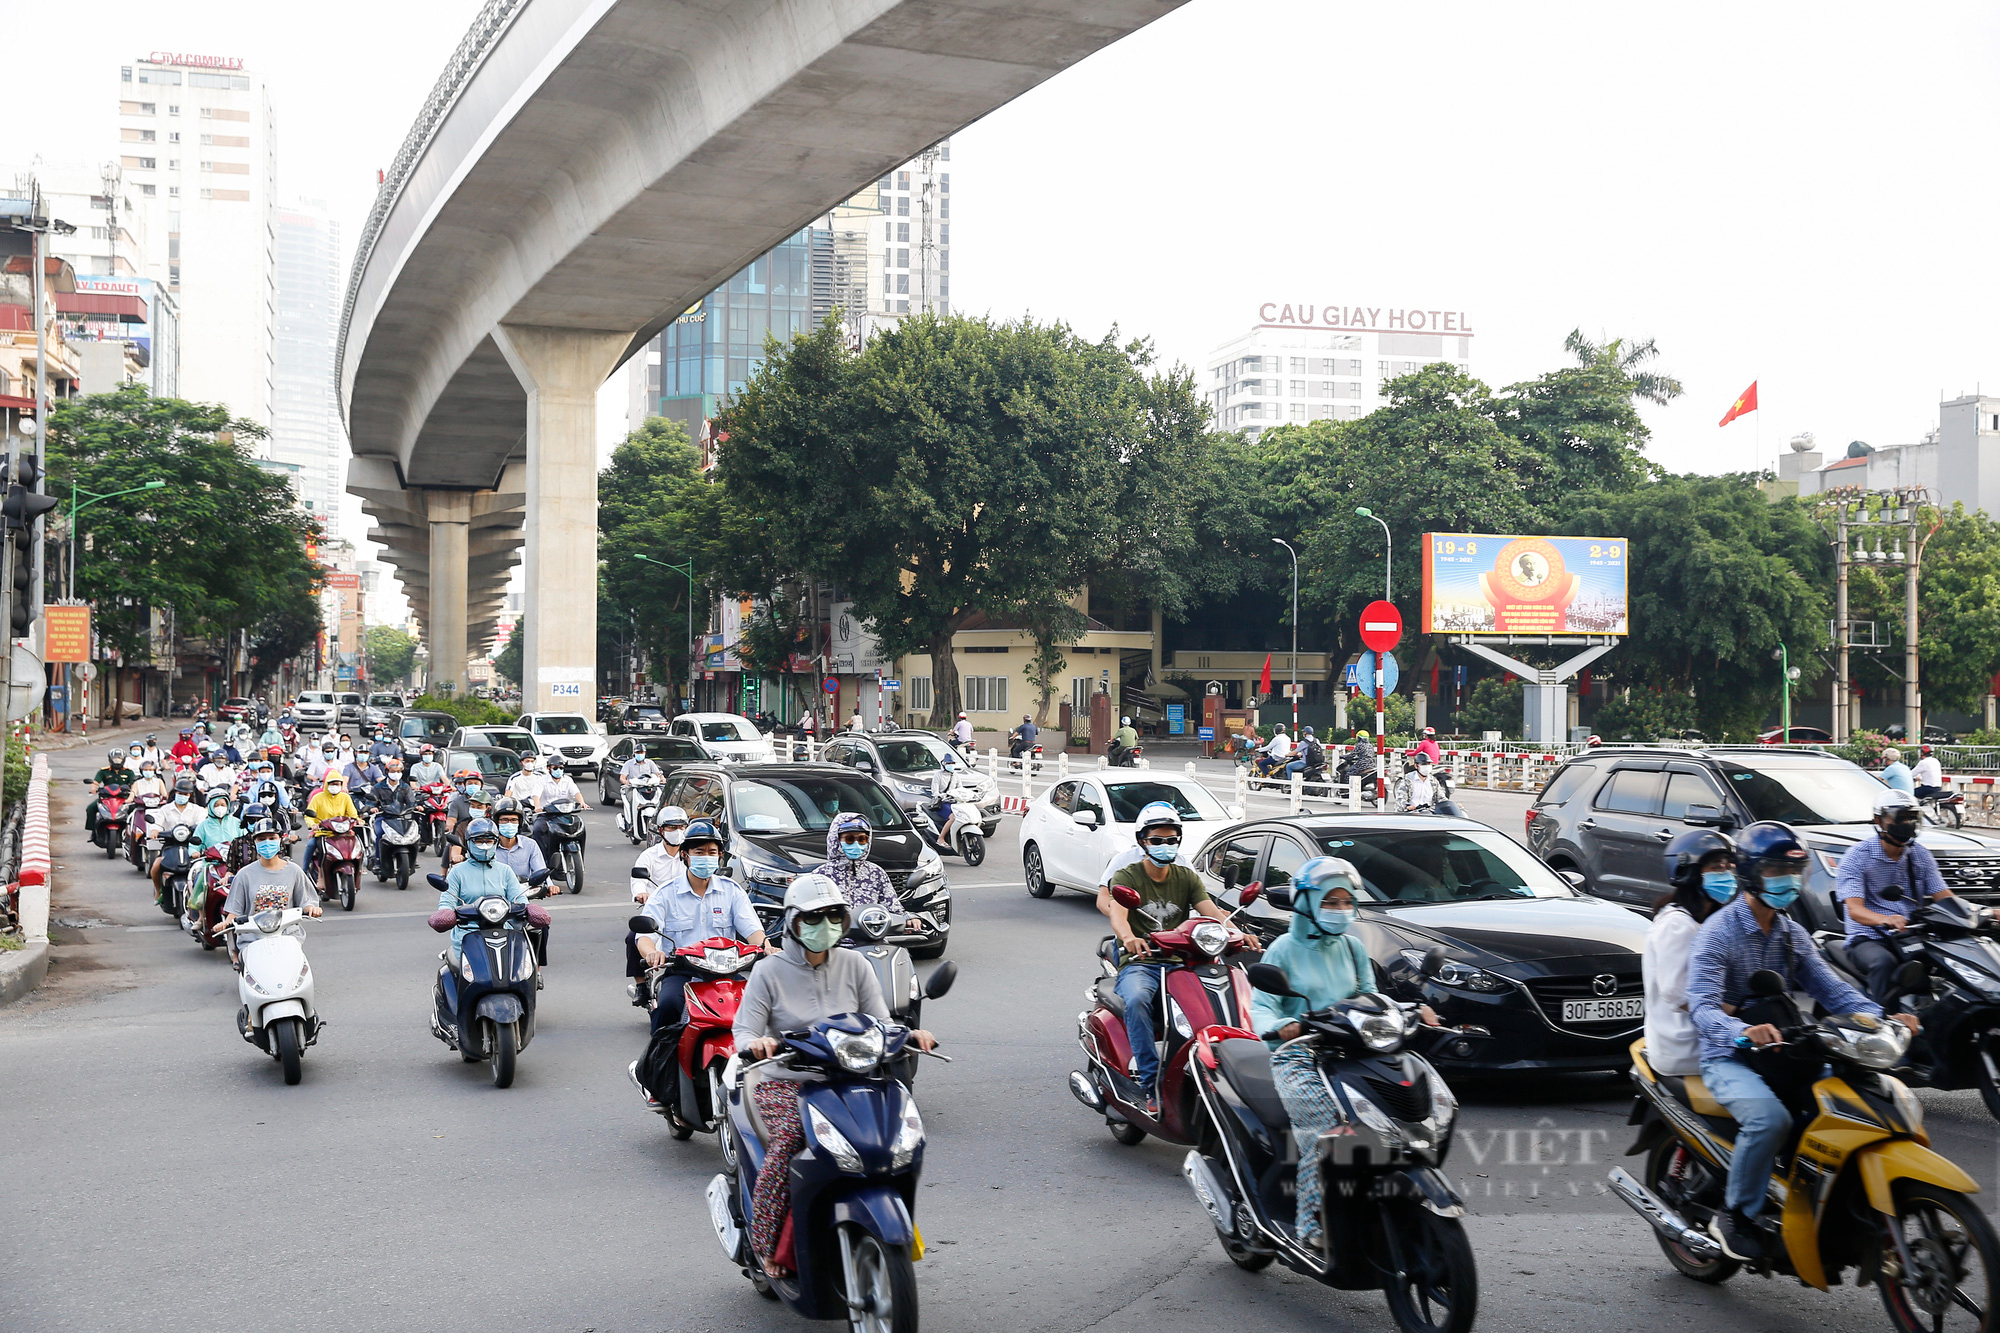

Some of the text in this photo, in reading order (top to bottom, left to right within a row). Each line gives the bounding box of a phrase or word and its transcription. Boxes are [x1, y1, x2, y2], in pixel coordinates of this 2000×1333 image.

[186, 54, 244, 69] COMPLEX
[1260, 303, 1472, 331] CAU GIAY HOTEL
[552, 685, 579, 694] P344
[1565, 1000, 1642, 1020] 30F-568.52
